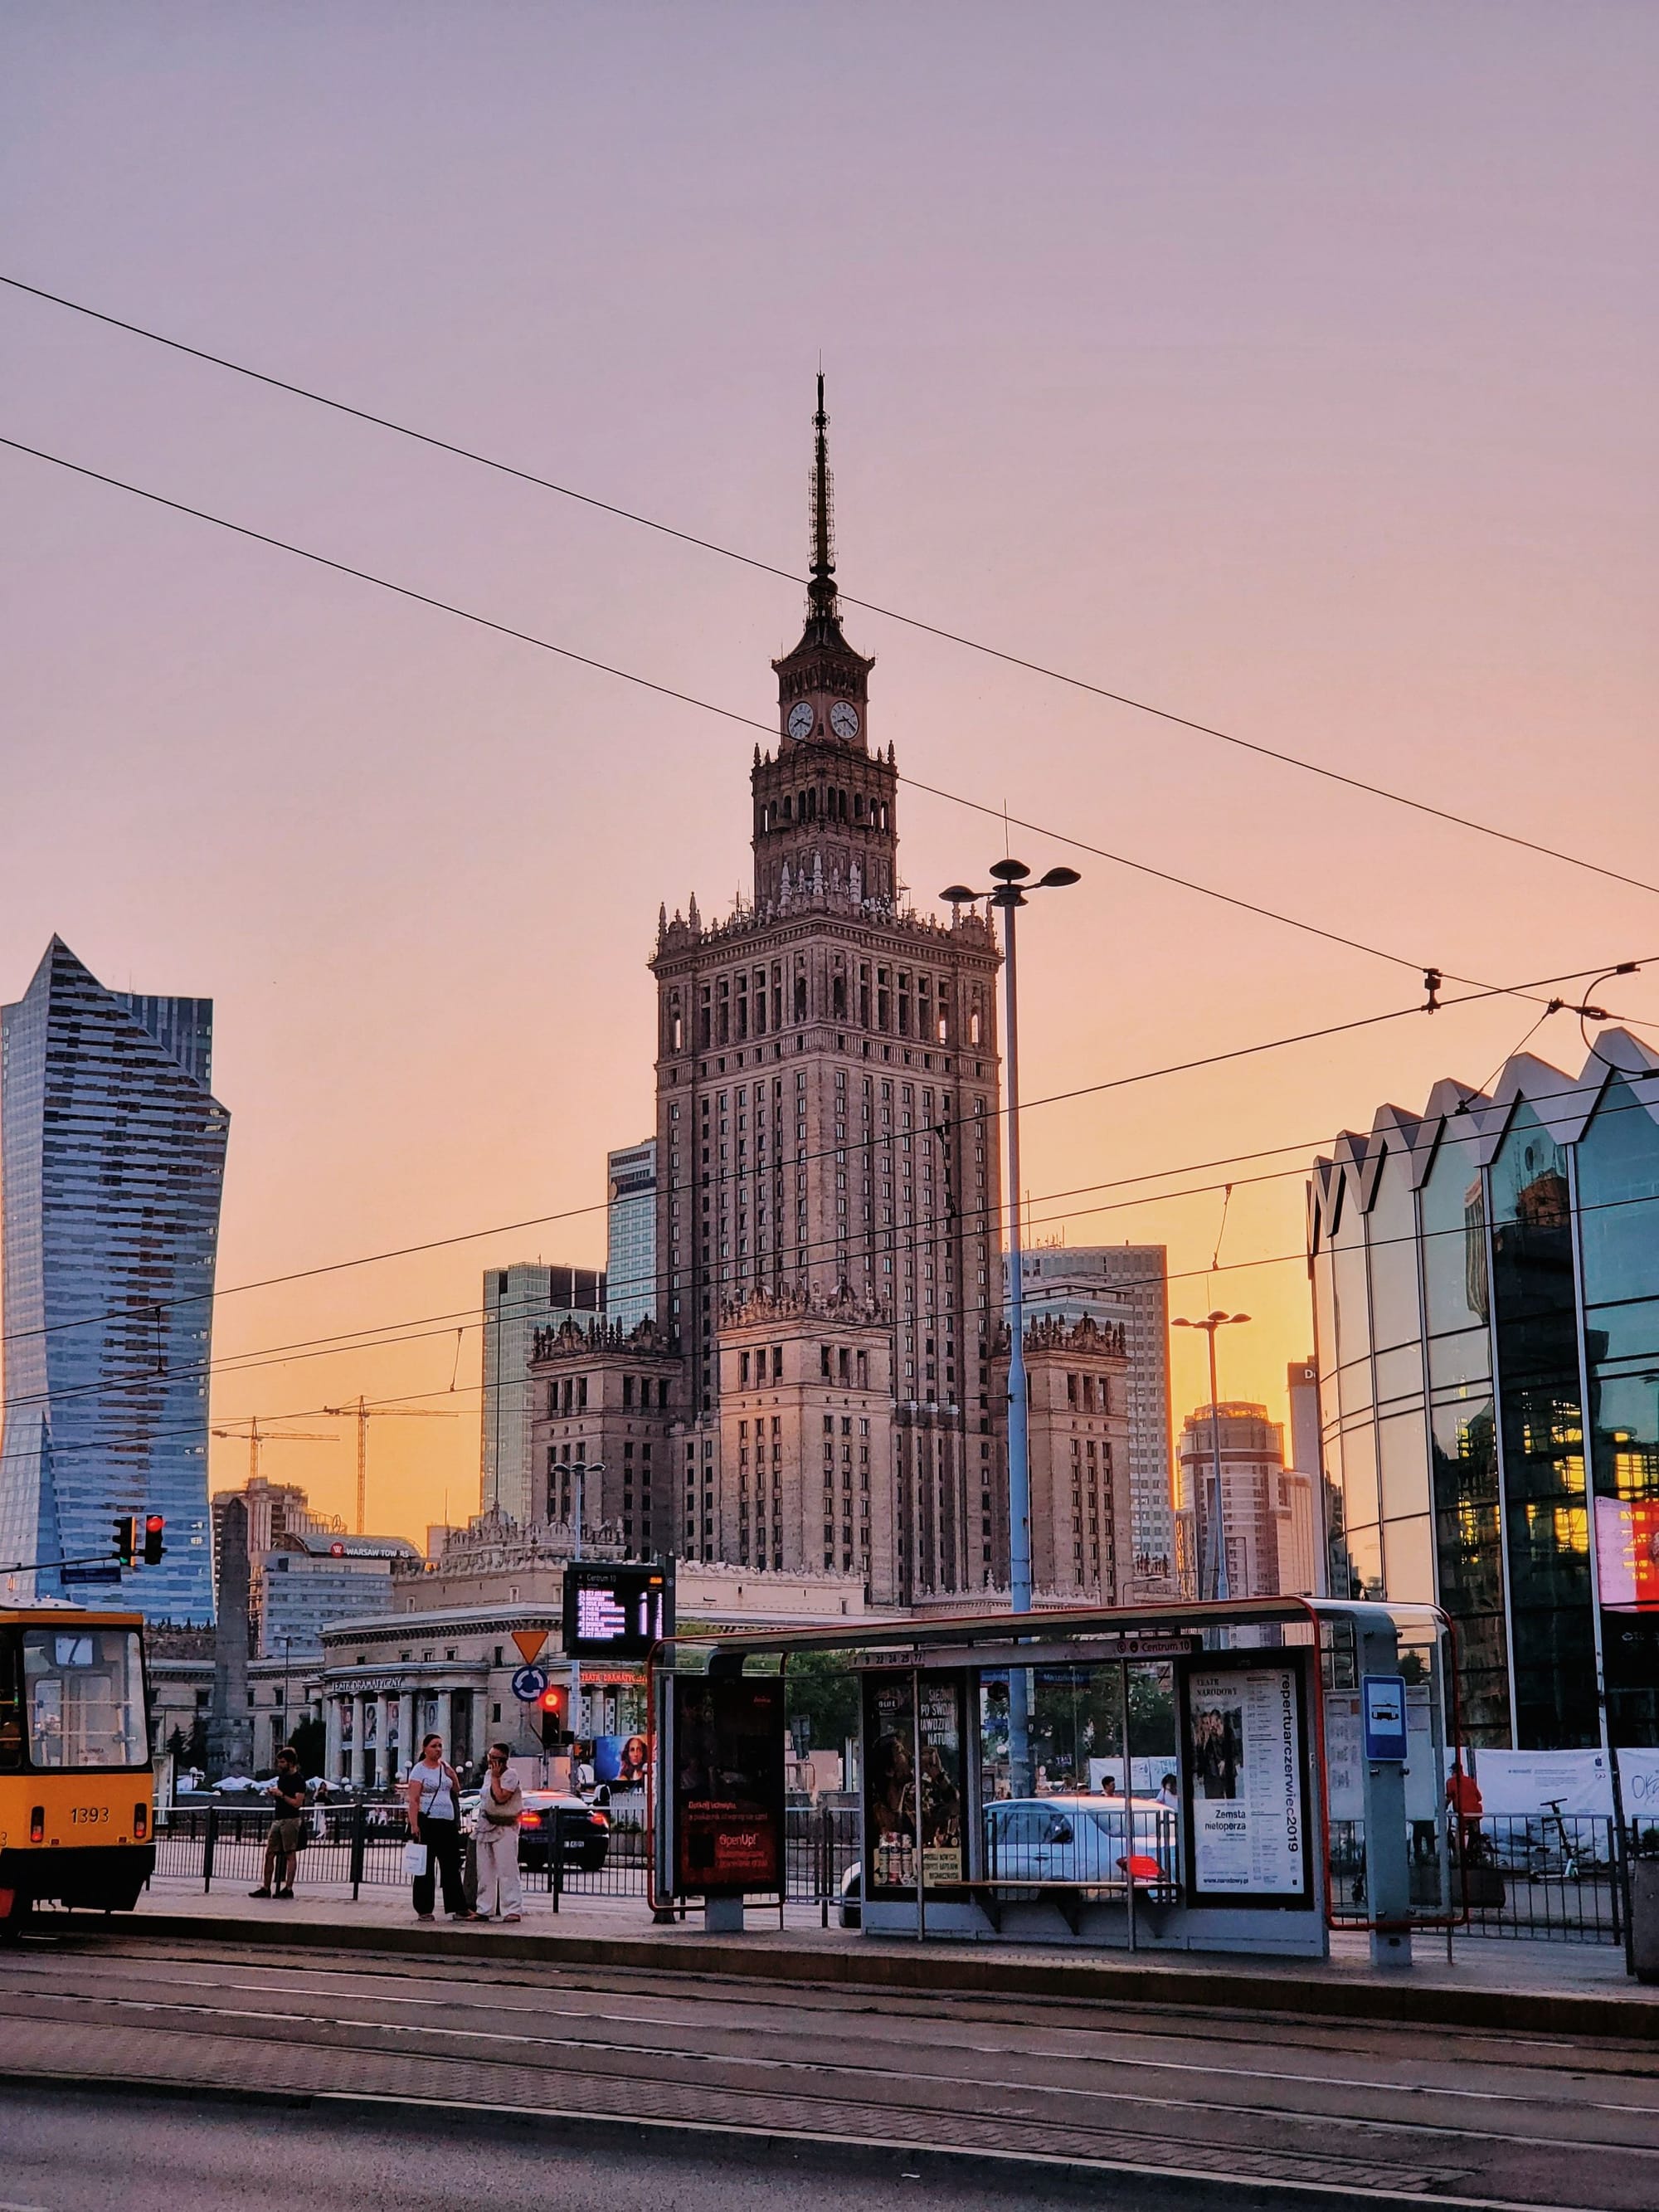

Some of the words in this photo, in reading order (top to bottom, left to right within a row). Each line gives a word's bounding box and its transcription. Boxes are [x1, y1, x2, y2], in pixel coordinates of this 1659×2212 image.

[1305, 1369, 1316, 1379] D
[347, 1548, 381, 1557] WARSAW
[382, 1549, 409, 1558] TOWRS
[586, 1573, 608, 1582] Centrum
[1141, 1643, 1177, 1652] Centrum
[1179, 1640, 1190, 1650] 10
[876, 1654, 884, 1664] 22
[581, 1673, 600, 1682] TEATR
[1197, 1678, 1219, 1687] TEATR
[351, 1677, 403, 1690] DRAMATYCZNY
[1197, 1687, 1237, 1696] NARODOWY
[921, 1704, 930, 1717] PO
[71, 1807, 109, 1824] 1393
[1215, 1810, 1246, 1819] Zemsta
[1205, 1821, 1246, 1832] nietoperza
[1203, 1877, 1248, 1885] www.narodowy.pl
